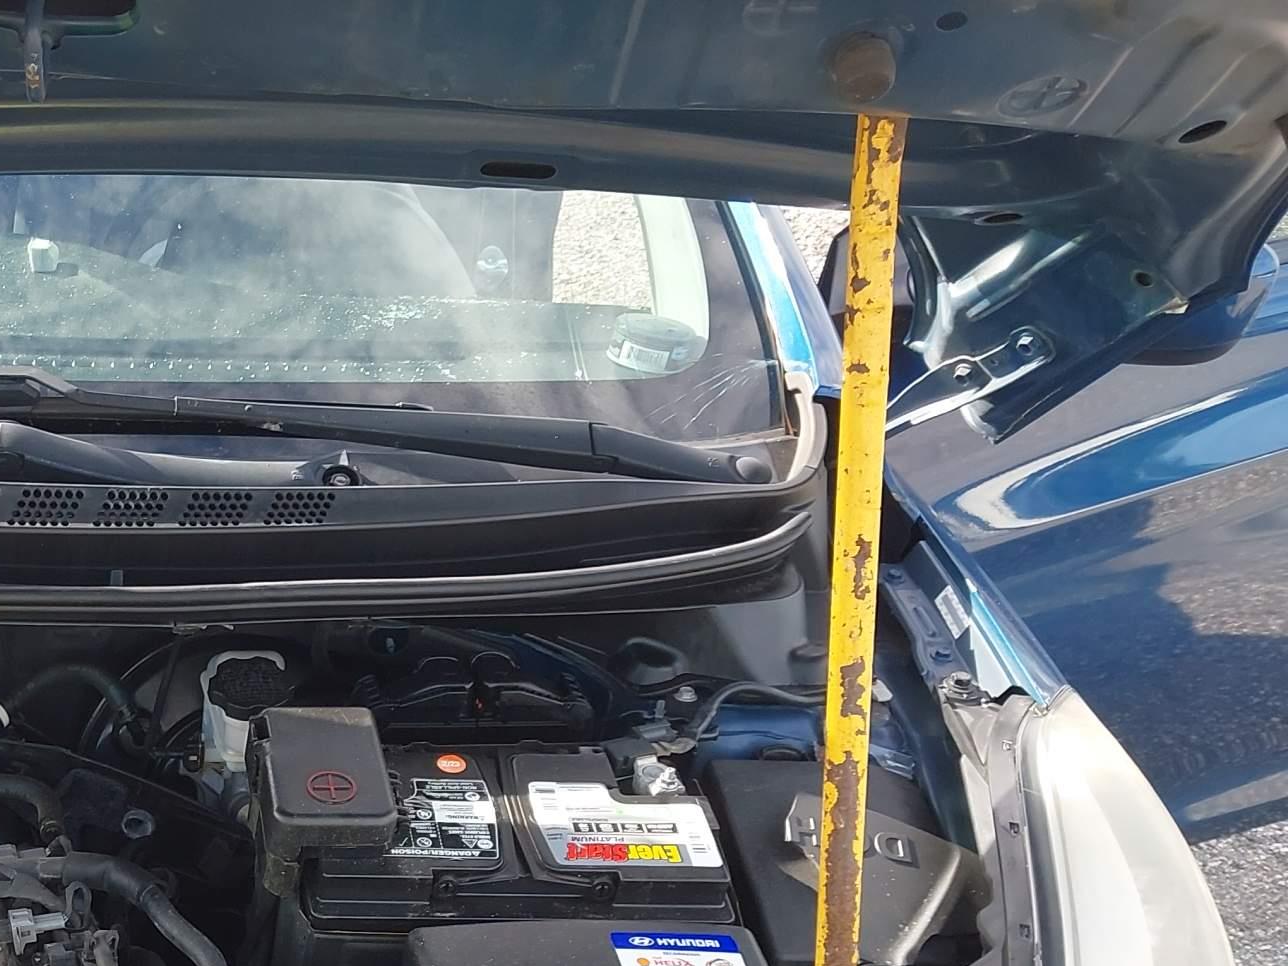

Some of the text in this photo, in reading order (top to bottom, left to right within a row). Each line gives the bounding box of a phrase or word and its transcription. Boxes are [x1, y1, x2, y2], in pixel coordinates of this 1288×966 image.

[391, 848, 473, 857] DANGER/POISON
[566, 842, 683, 863] EverStart
[656, 937, 721, 948] HYUNDAI
